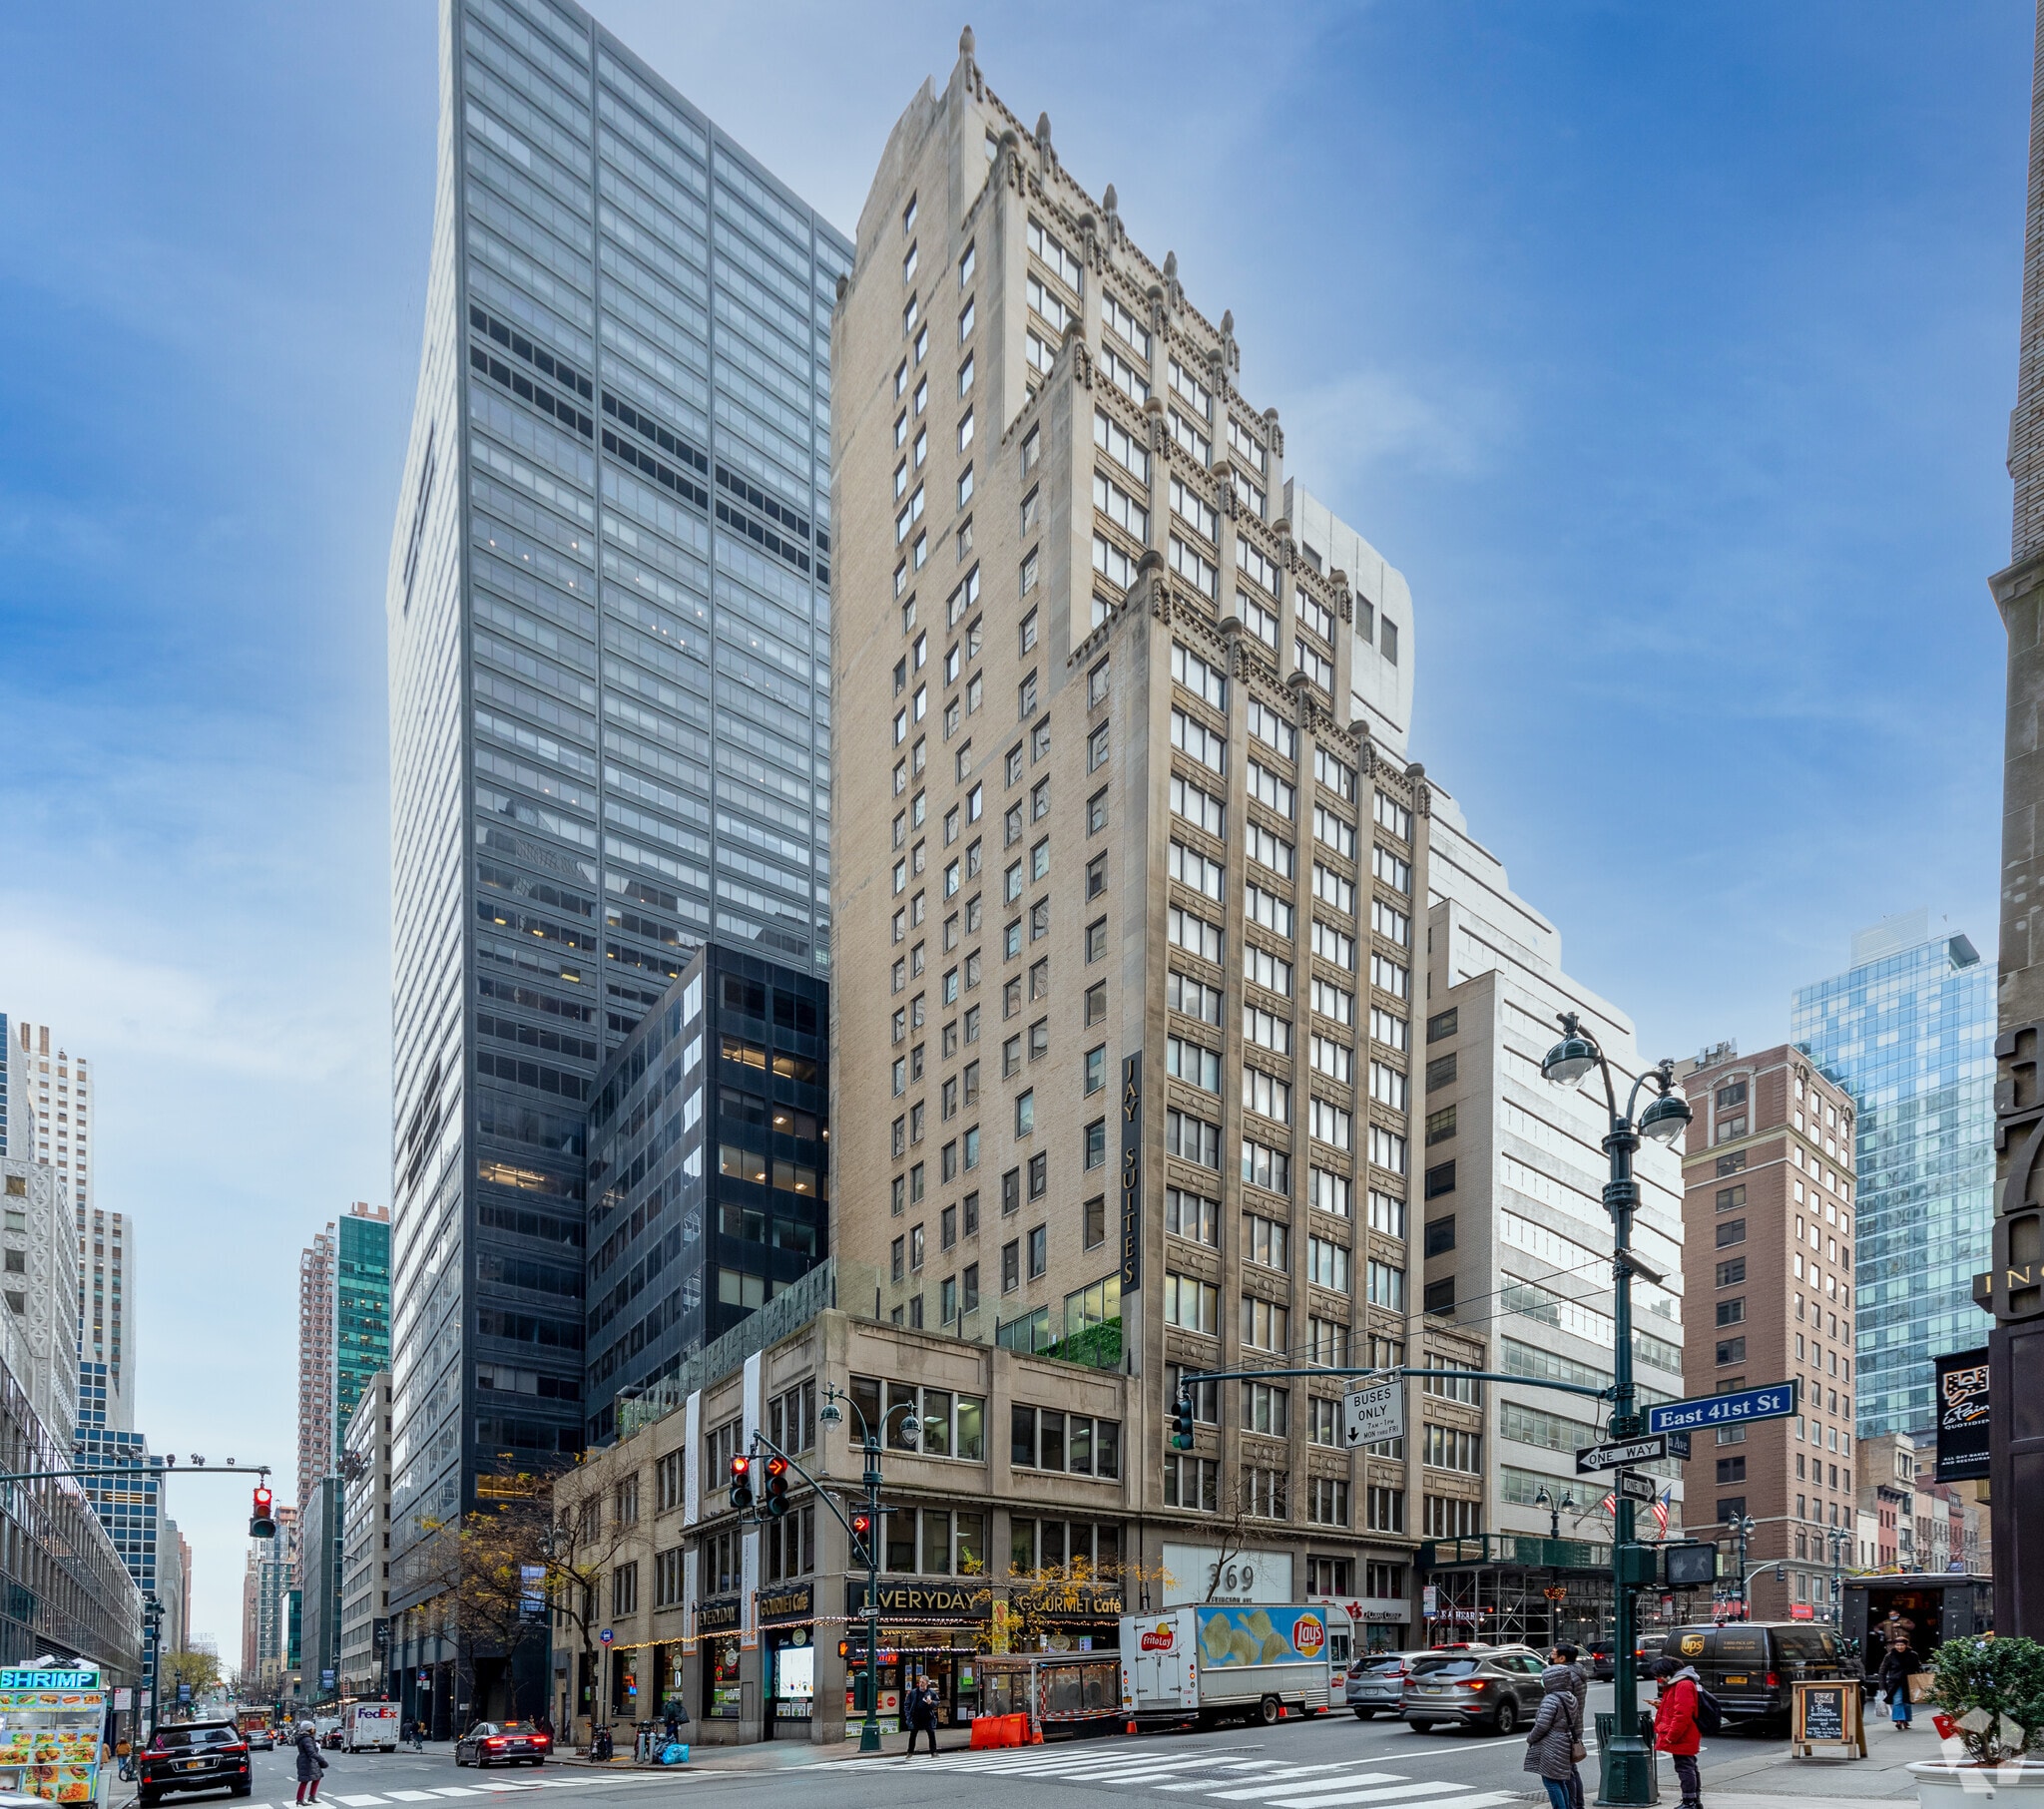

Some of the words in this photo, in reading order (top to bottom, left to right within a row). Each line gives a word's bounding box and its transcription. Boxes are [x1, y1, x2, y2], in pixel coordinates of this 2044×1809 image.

[1124, 1059, 1137, 1122] JAY
[1123, 1147, 1137, 1284] SUITES
[1354, 1388, 1391, 1407] BUSES
[1358, 1405, 1387, 1421] ONLY
[1660, 1409, 1703, 1428] East
[1708, 1401, 1751, 1419] 41st
[1757, 1395, 1781, 1412] St
[1388, 1425, 1399, 1434] FRI
[1674, 1438, 1688, 1451] Ave
[1589, 1451, 1614, 1465] ONE
[1626, 1443, 1655, 1458] WAY
[1627, 1479, 1638, 1492] ONE
[1208, 1564, 1254, 1590] 369
[761, 1595, 792, 1616] GOURMET
[792, 1589, 808, 1611] Café
[864, 1589, 976, 1610] EVERYDAY
[1019, 1595, 1090, 1612] GOURMET
[1093, 1596, 1122, 1613] Café
[700, 1605, 737, 1626] EVERYDAY
[1455, 1610, 1485, 1619] HEARY
[1683, 1640, 1703, 1652] ups
[1, 1672, 93, 1687] SHRIMP
[358, 1707, 398, 1718] FedEx
